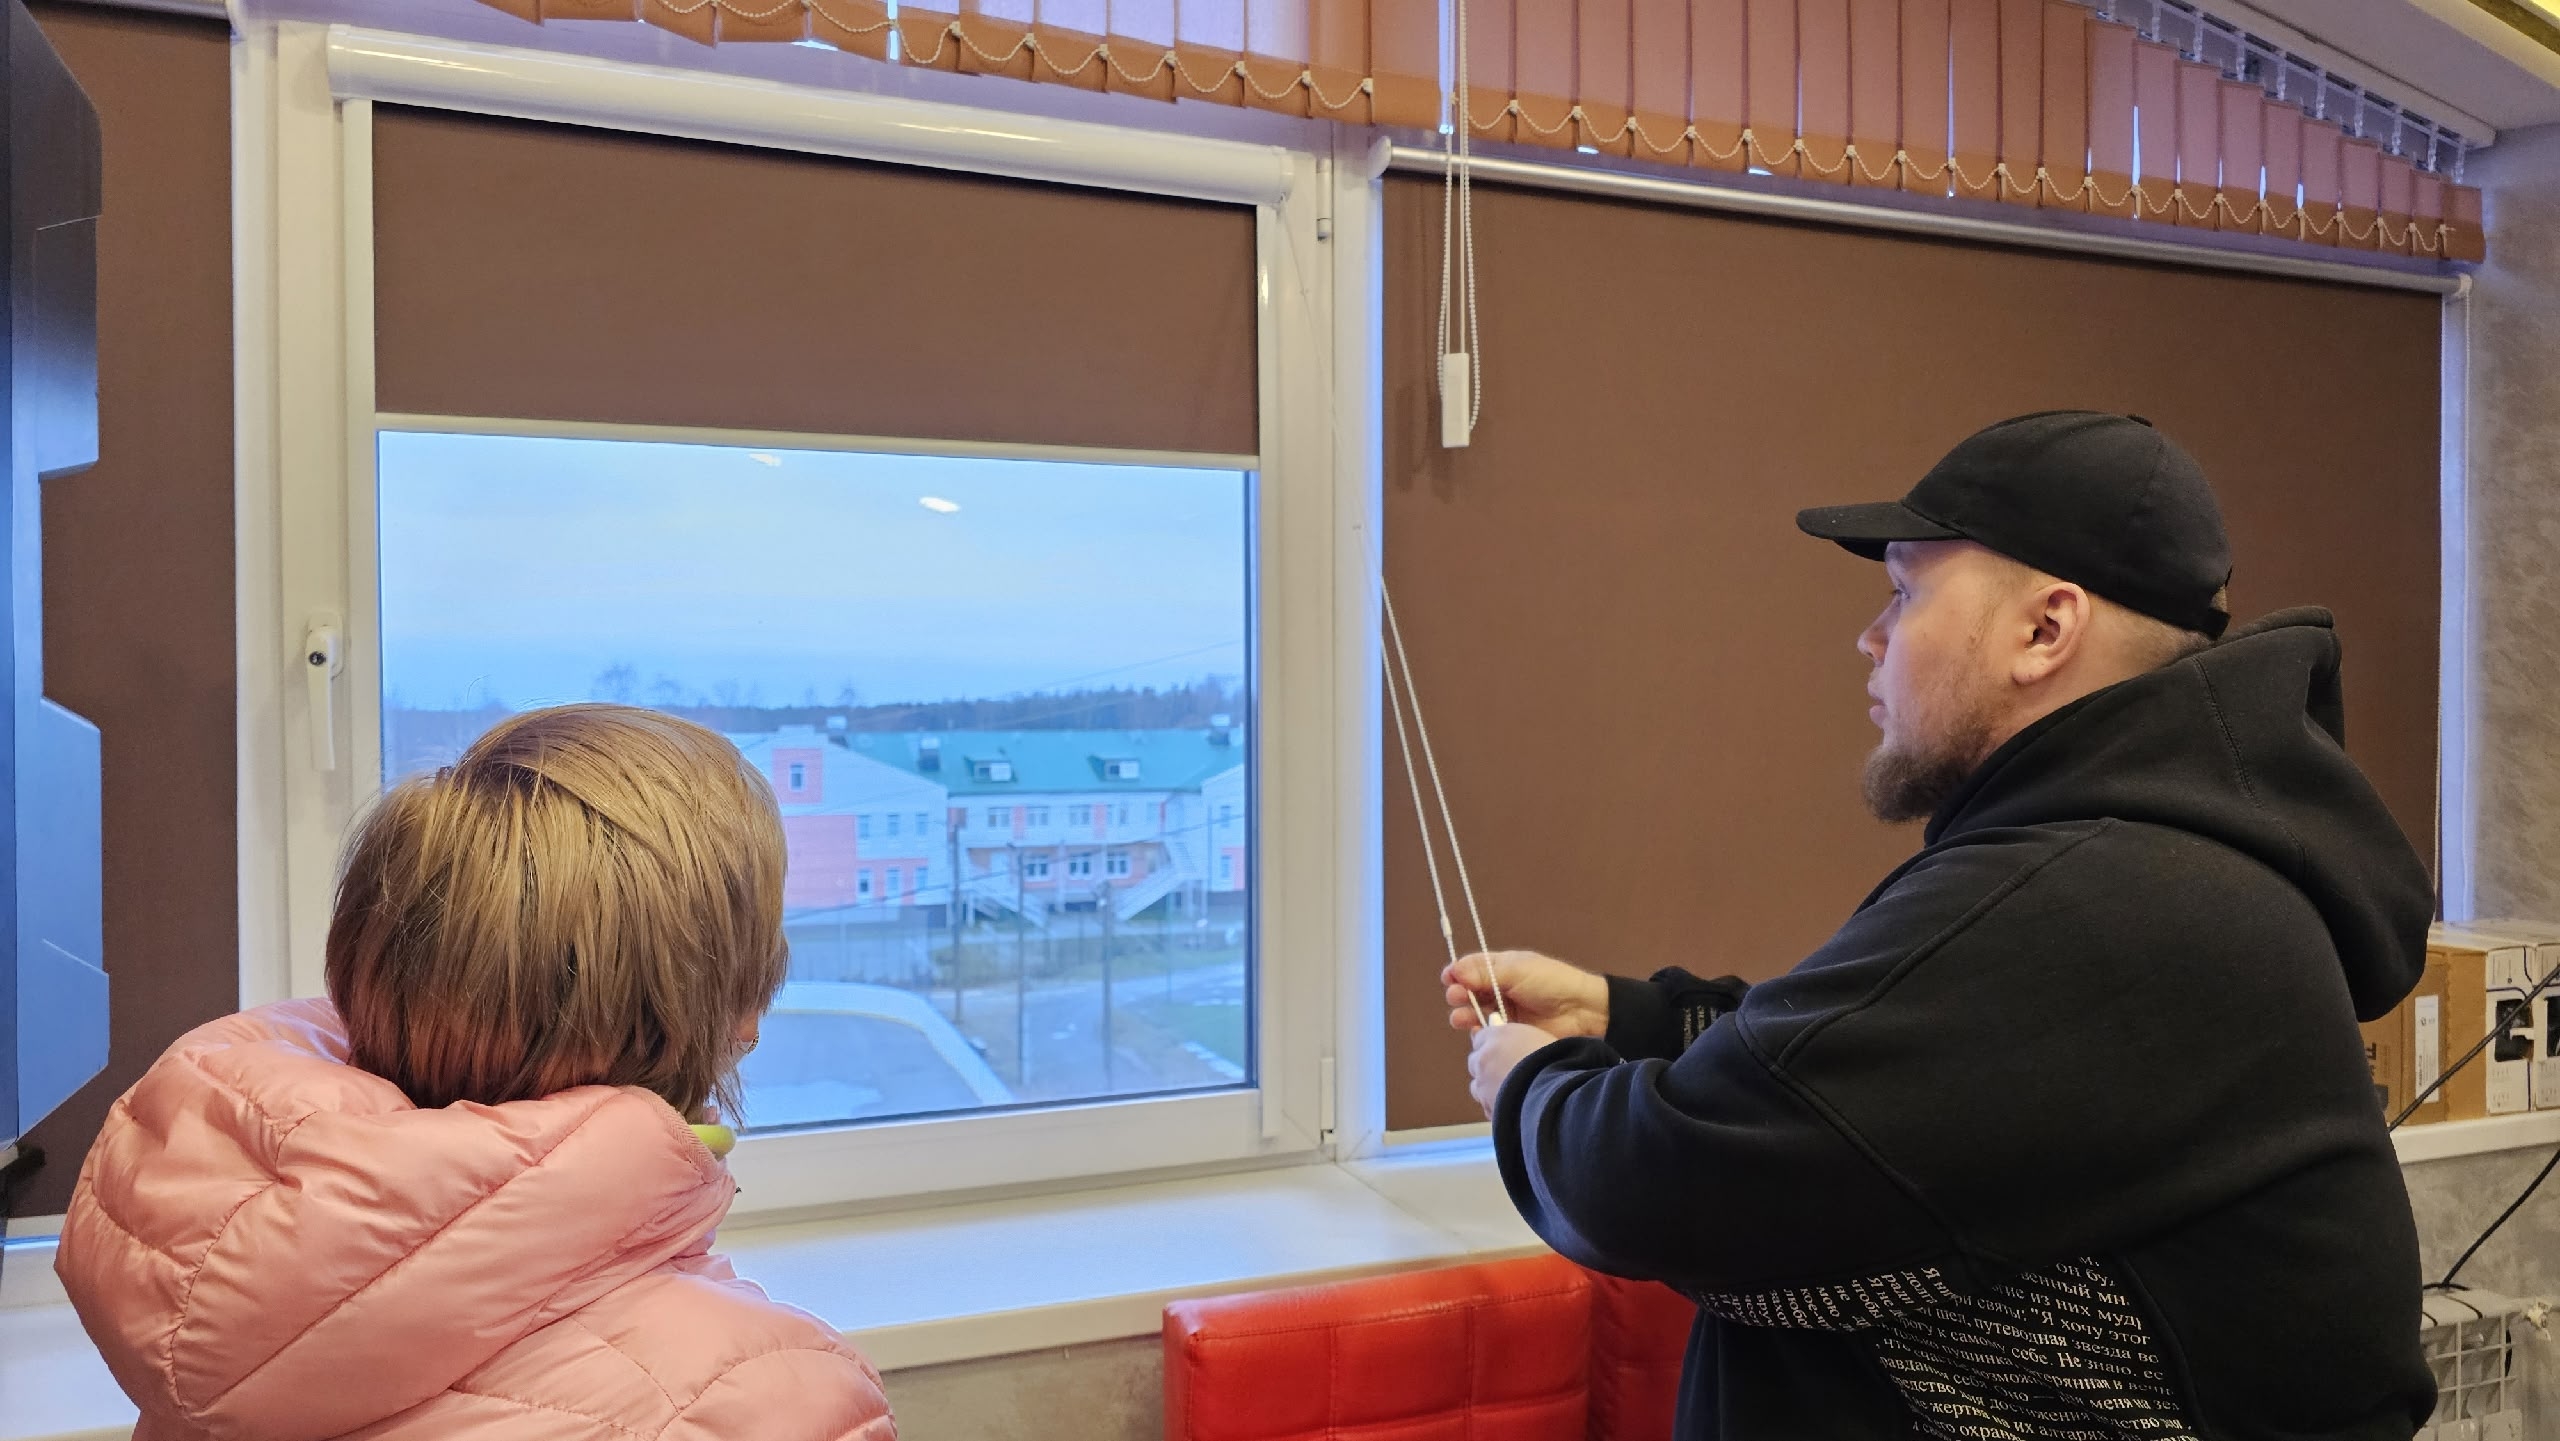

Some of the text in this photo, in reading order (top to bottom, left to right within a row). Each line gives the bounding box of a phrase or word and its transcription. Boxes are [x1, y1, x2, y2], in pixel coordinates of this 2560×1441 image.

[1865, 1276, 1885, 1289] Я
[1920, 1266, 1941, 1280] Я
[2085, 1268, 2116, 1287] бу
[1851, 1278, 1885, 1319] чтобы
[2016, 1271, 2130, 1306] венный мн
[1799, 1288, 1836, 1332] кое-чт
[1815, 1286, 1840, 1318] мою
[2030, 1292, 2051, 1306] из
[2055, 1298, 2091, 1317] них
[1973, 1316, 2068, 1347] путеводная
[2071, 1339, 2132, 1360] звезда
[2137, 1352, 2159, 1364] во
[2060, 1318, 2103, 1340] хочу
[2056, 1352, 2082, 1368] Не
[2012, 1421, 2035, 1435] их
